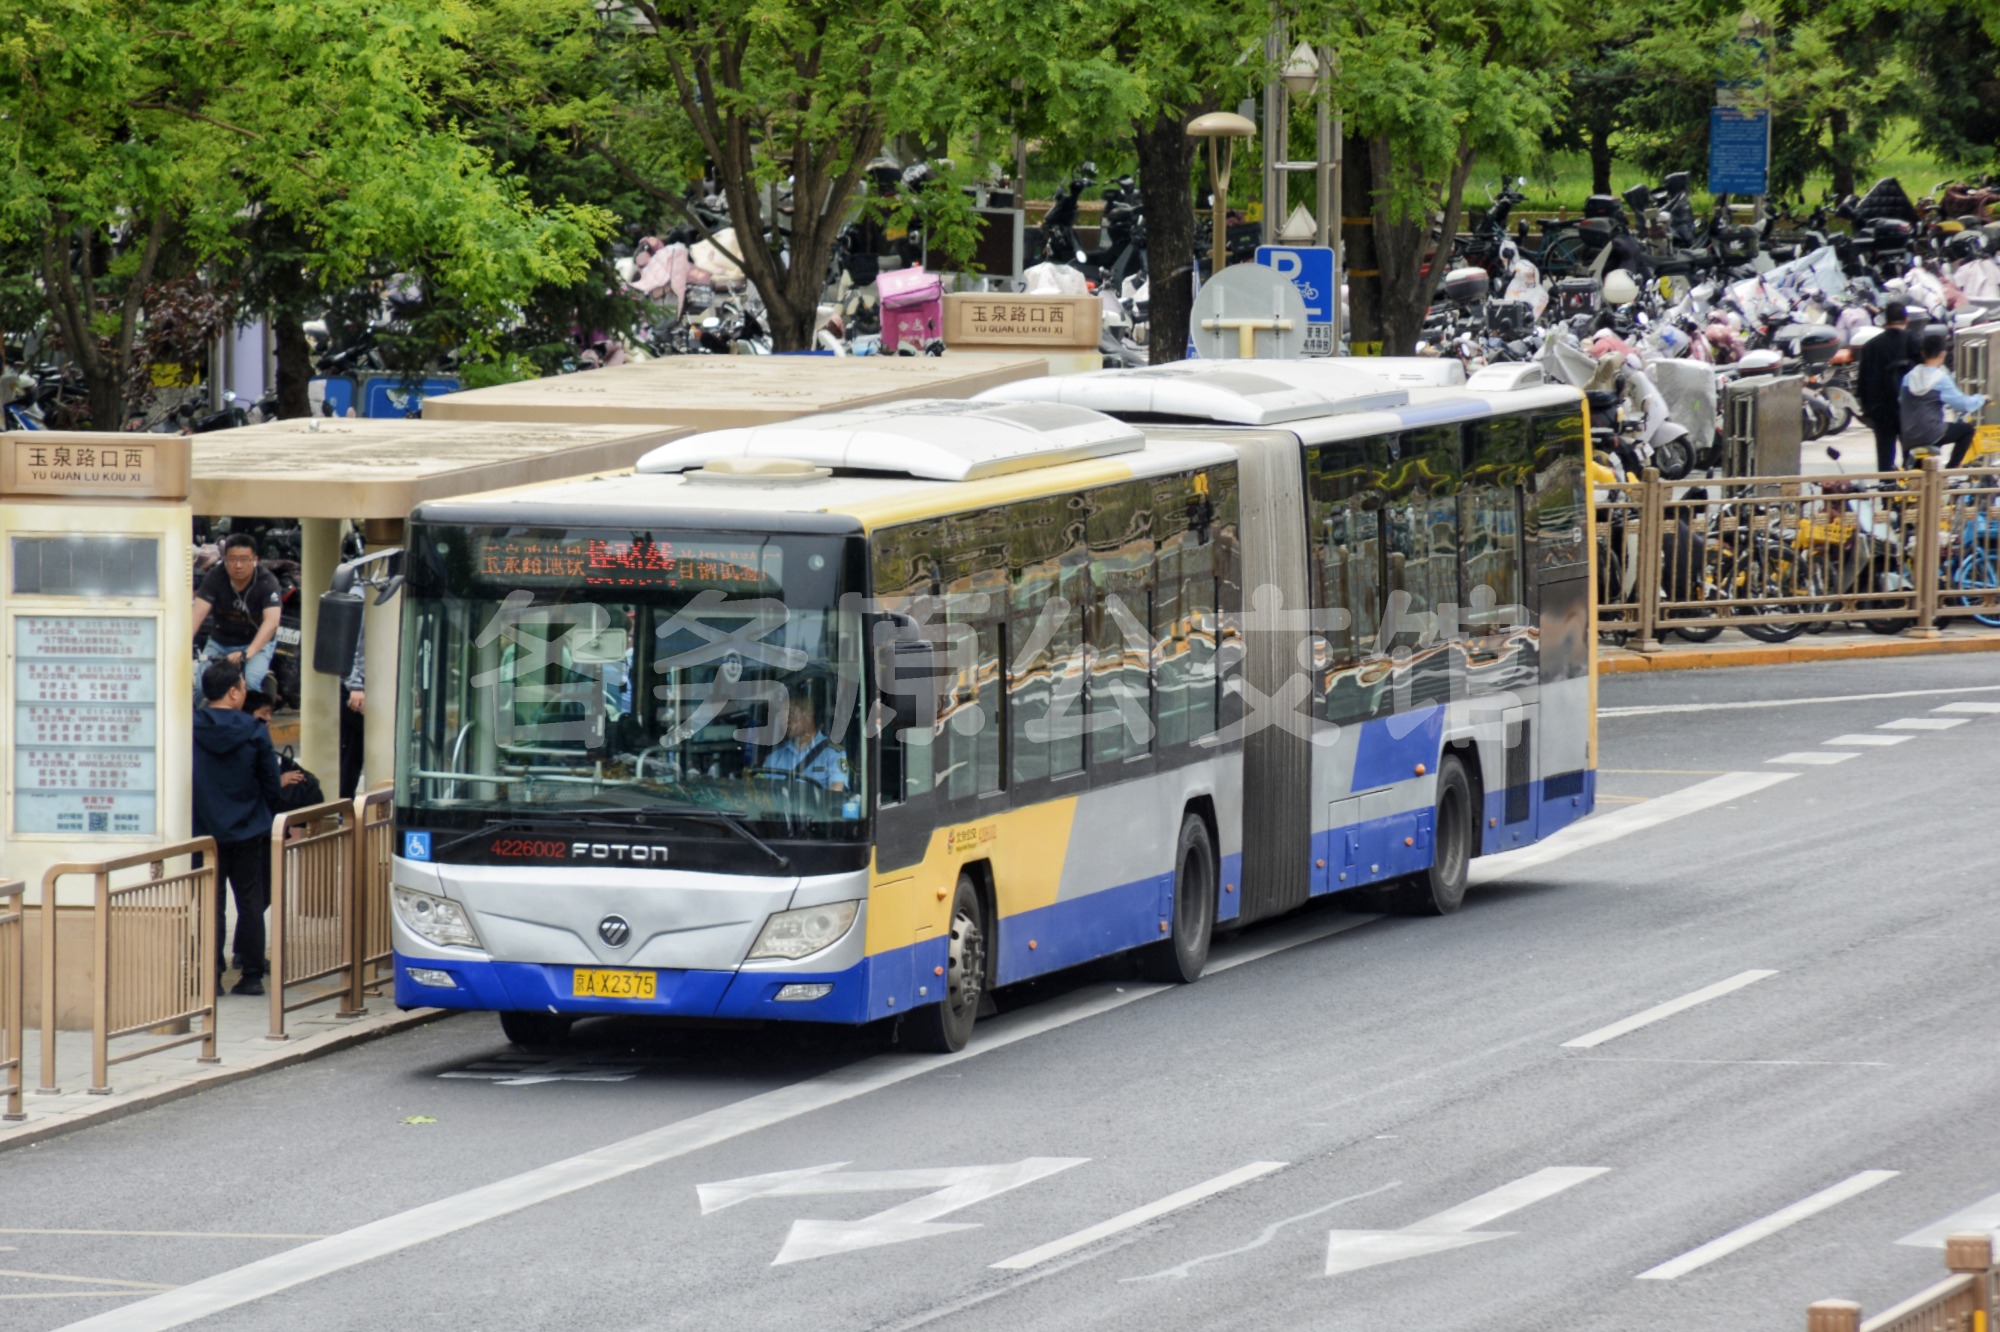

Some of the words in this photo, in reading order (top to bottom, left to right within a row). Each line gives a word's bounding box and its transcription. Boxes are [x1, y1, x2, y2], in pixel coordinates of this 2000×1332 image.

[972, 306, 1064, 322] 玉泉路口西
[974, 325, 987, 333] YU
[989, 325, 1014, 333] QUAN
[1016, 325, 1029, 333] LU
[1031, 325, 1051, 333] KOU
[1053, 326, 1063, 334] XI
[28, 447, 143, 468] 玉泉路口西
[32, 471, 47, 480] YU
[50, 471, 81, 481] QUAN
[84, 473, 99, 481] LU
[102, 473, 126, 481] KOU
[130, 473, 141, 482] XI
[491, 839, 566, 858] 4226002
[572, 843, 668, 861] FOTON
